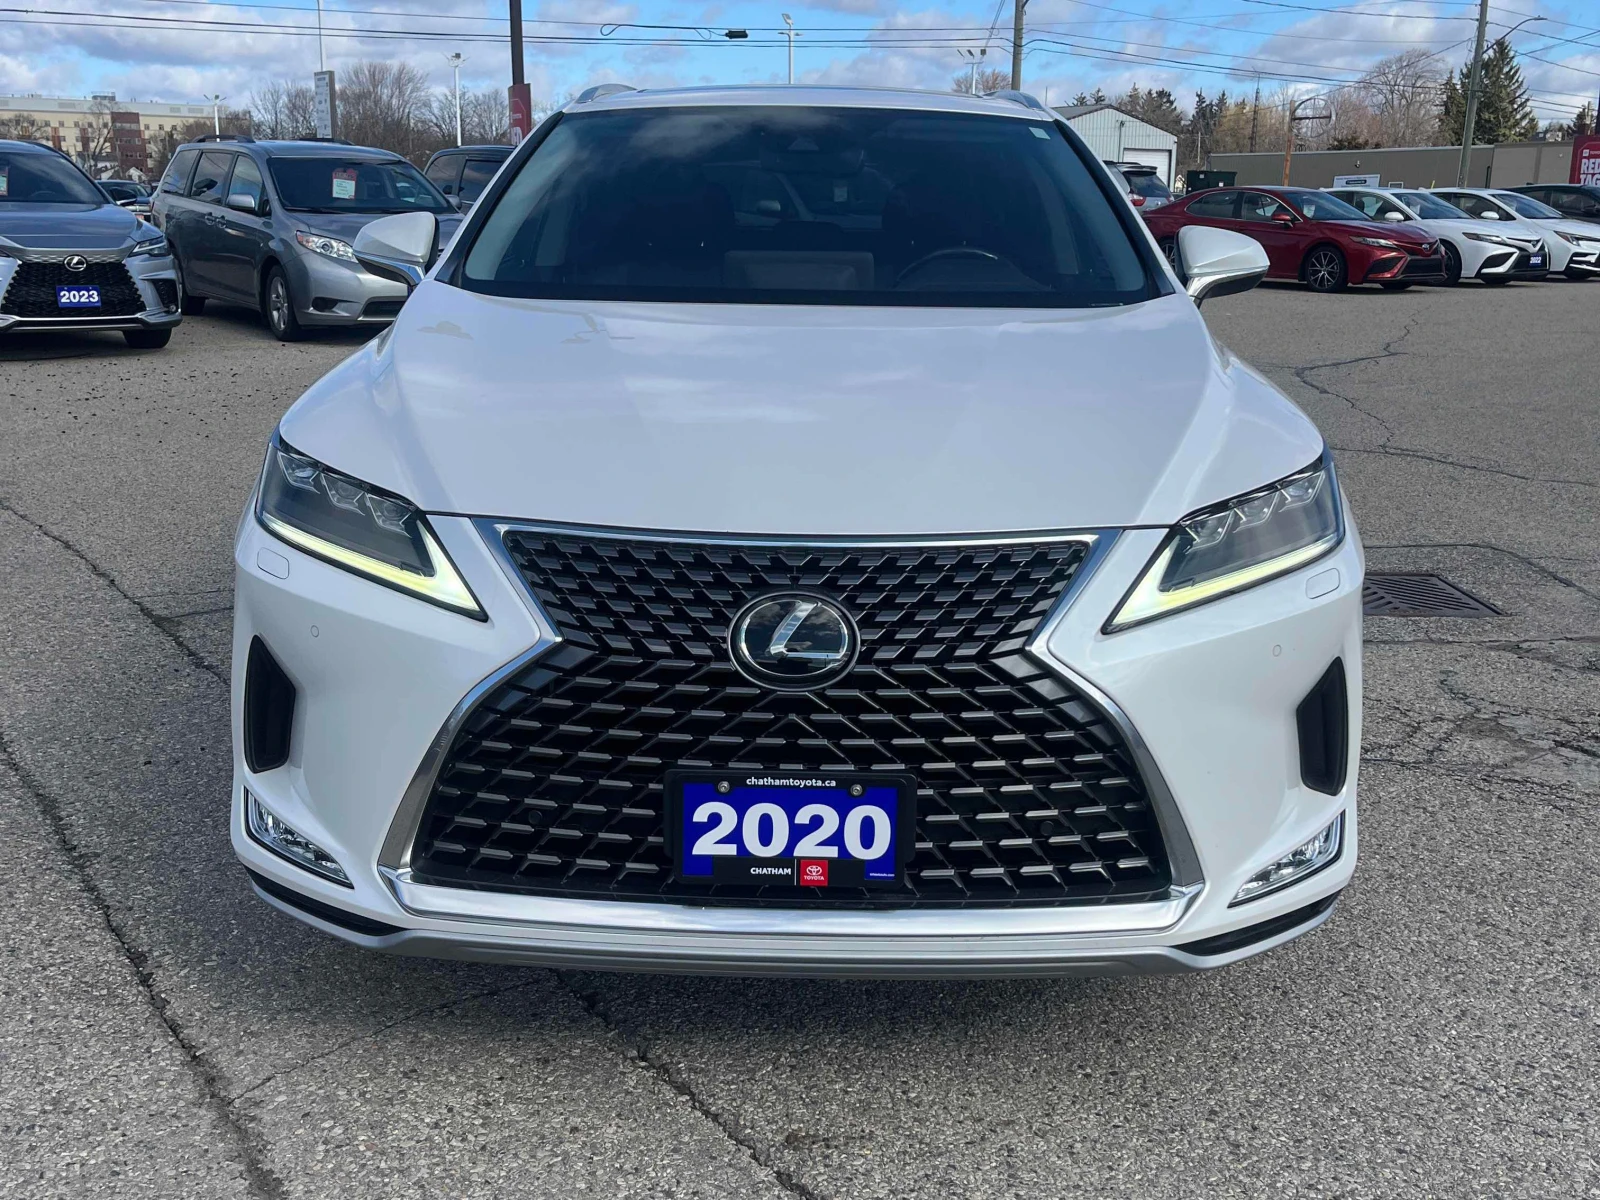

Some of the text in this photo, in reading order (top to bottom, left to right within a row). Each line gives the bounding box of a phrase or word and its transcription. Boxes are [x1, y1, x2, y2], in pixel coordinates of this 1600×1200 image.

[60, 290, 99, 303] 2023
[746, 777, 836, 788] chathamtoyota.ca
[691, 801, 892, 860] 2020
[750, 867, 792, 876] CHATHAM
